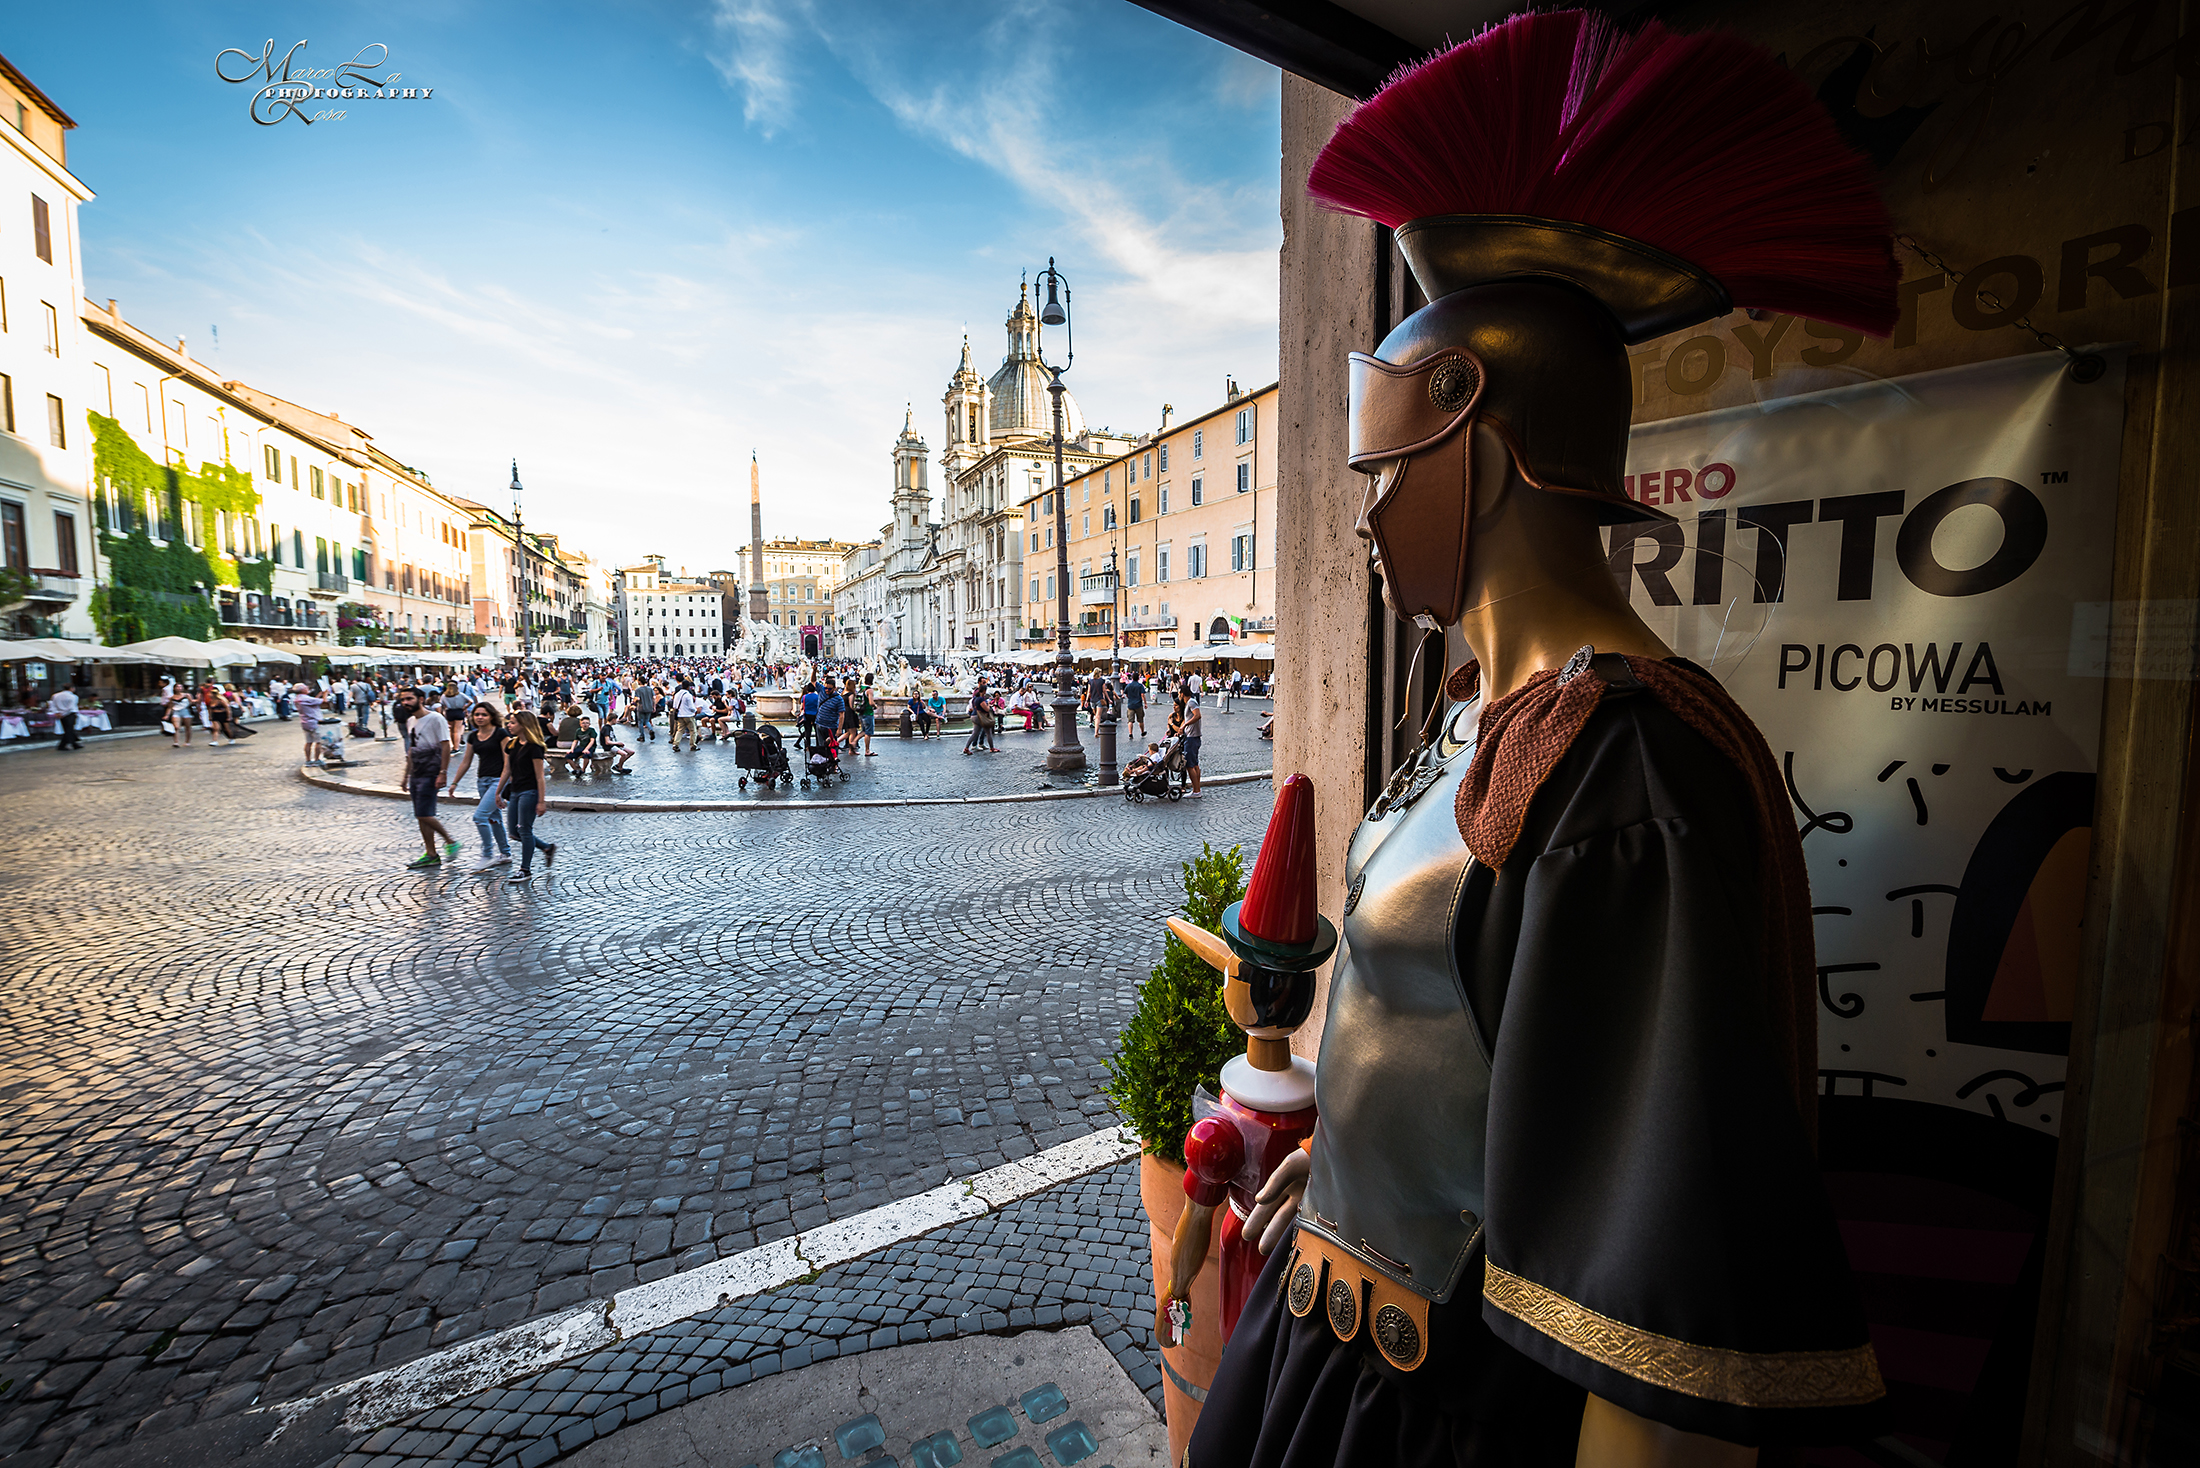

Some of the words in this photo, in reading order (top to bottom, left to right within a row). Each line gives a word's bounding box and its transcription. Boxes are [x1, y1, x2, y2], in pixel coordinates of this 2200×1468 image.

[1778, 642, 2005, 695] PICOWA
[1891, 697, 1916, 710] BY
[1921, 698, 2052, 716] MESSULAM
